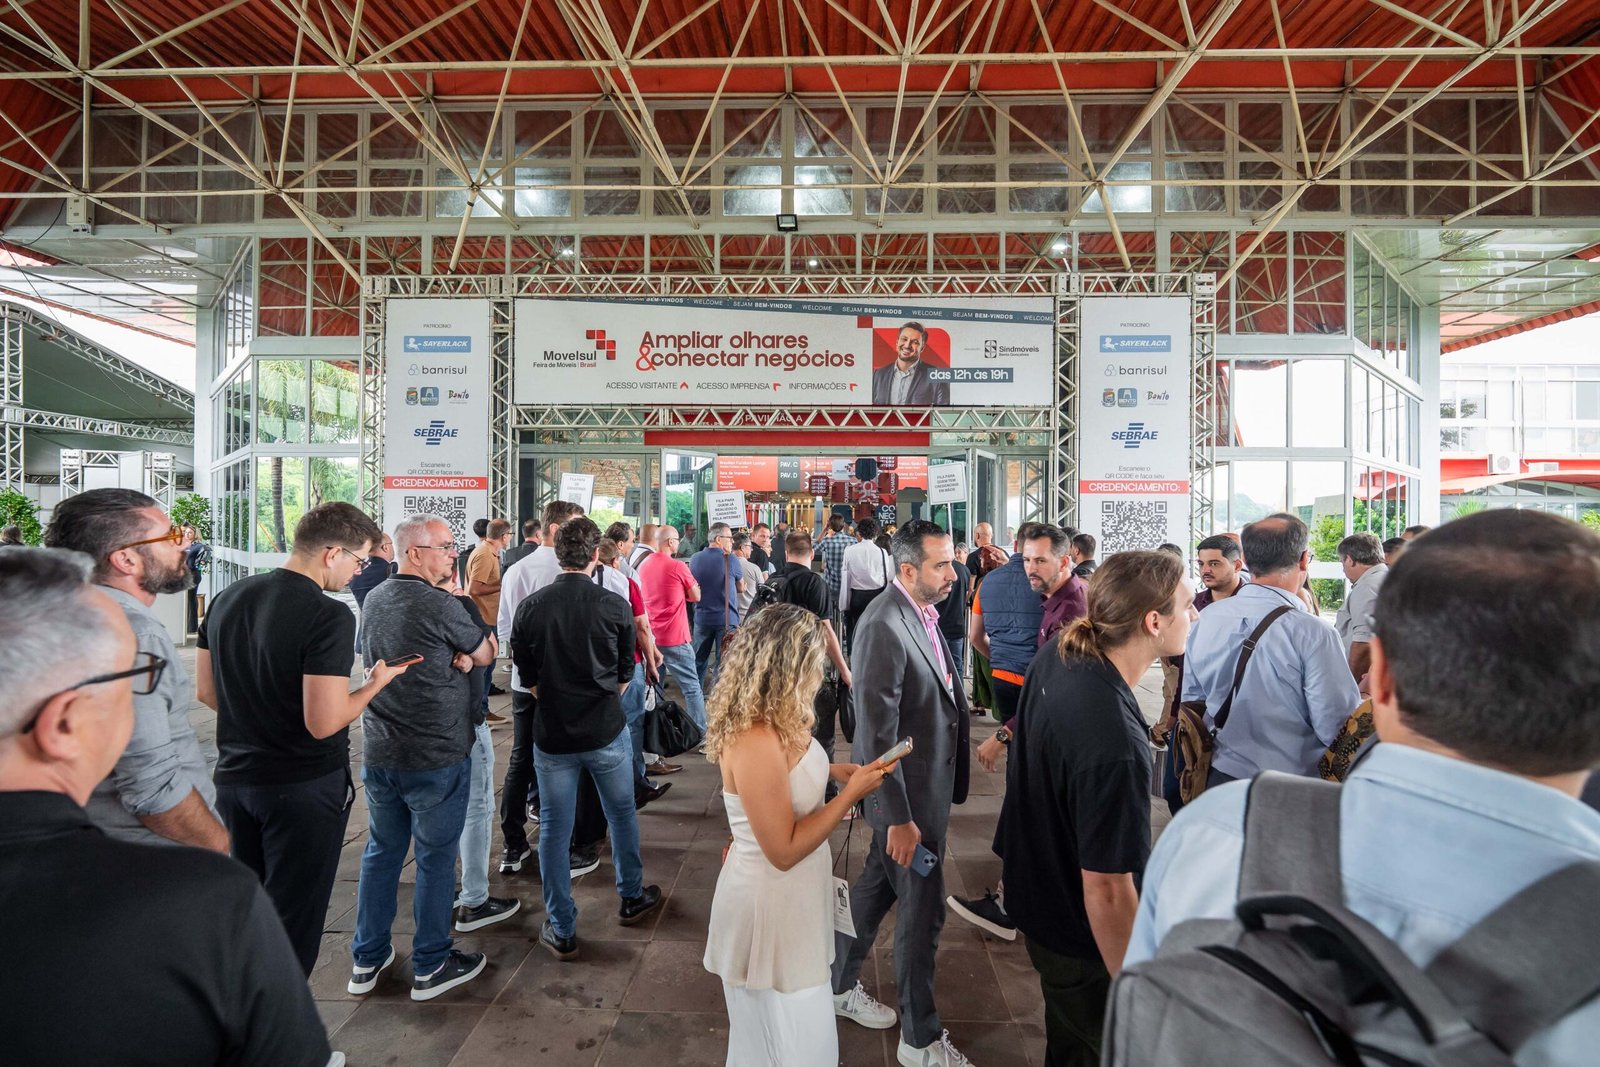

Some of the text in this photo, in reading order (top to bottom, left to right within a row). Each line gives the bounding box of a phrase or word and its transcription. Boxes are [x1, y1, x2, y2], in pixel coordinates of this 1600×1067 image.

[641, 331, 809, 352] Ampliar olhares
[544, 350, 596, 360] Movelsul
[755, 350, 855, 371] negócios
[422, 365, 467, 374] banrisul
[1119, 365, 1167, 375] banrisul
[929, 370, 1008, 380] das 12h às 19h
[789, 382, 846, 391] INFORMAÇÕES
[414, 428, 458, 437] SEBRAE
[1111, 431, 1158, 440] SEBRAE
[392, 478, 479, 487] CREDENCIAMENTO:
[1089, 482, 1180, 492] CREDENCIAMENTO:
